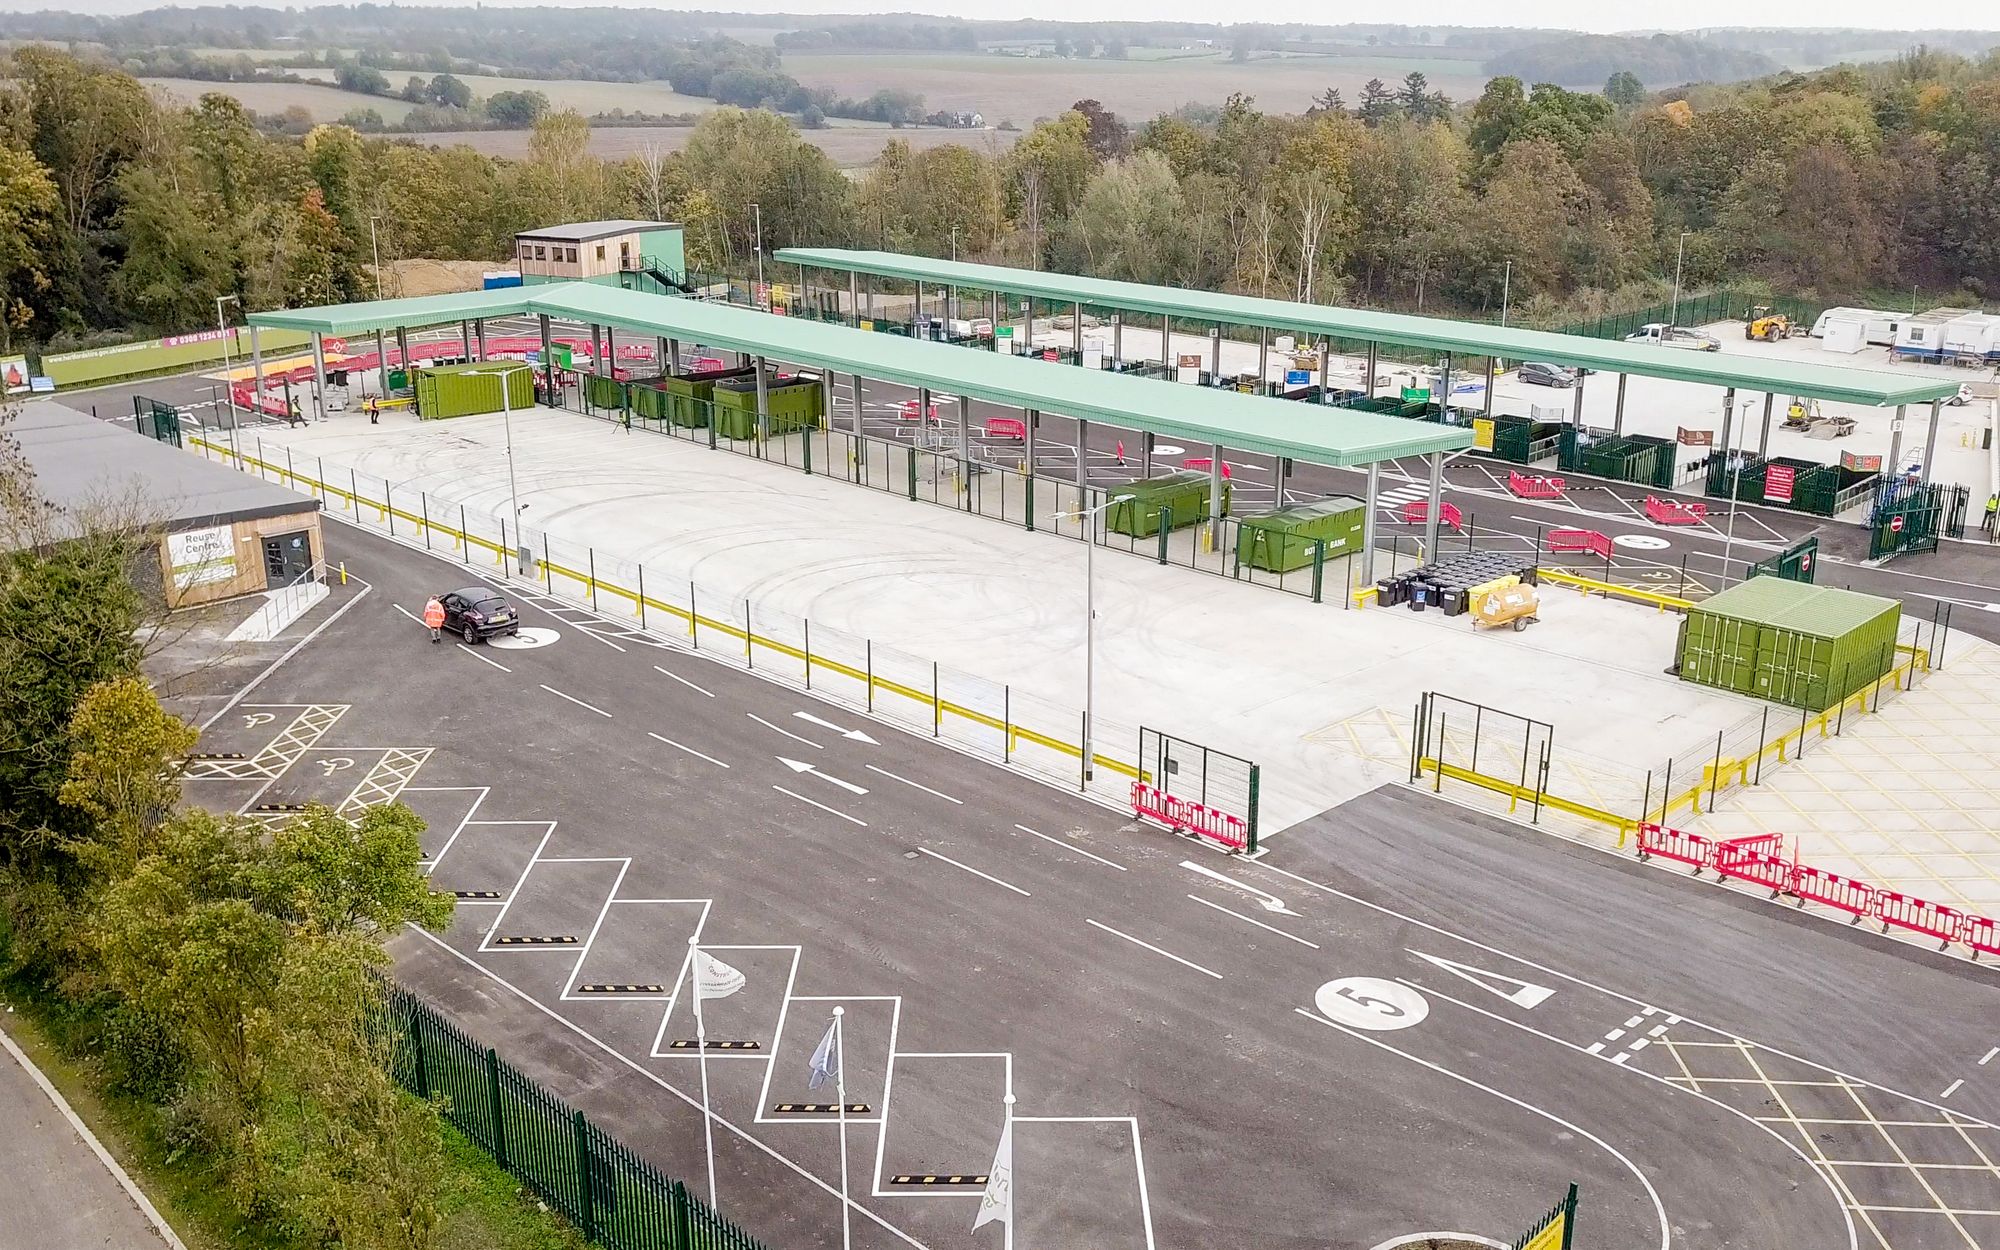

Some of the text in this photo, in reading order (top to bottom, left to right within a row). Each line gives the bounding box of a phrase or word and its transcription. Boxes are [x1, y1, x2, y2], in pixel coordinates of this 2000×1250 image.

[217, 329, 230, 339] 01
[185, 532, 216, 544] Reuse
[1330, 537, 1347, 549] BANK
[185, 542, 220, 554] Centre
[1335, 986, 1406, 1017] 5
